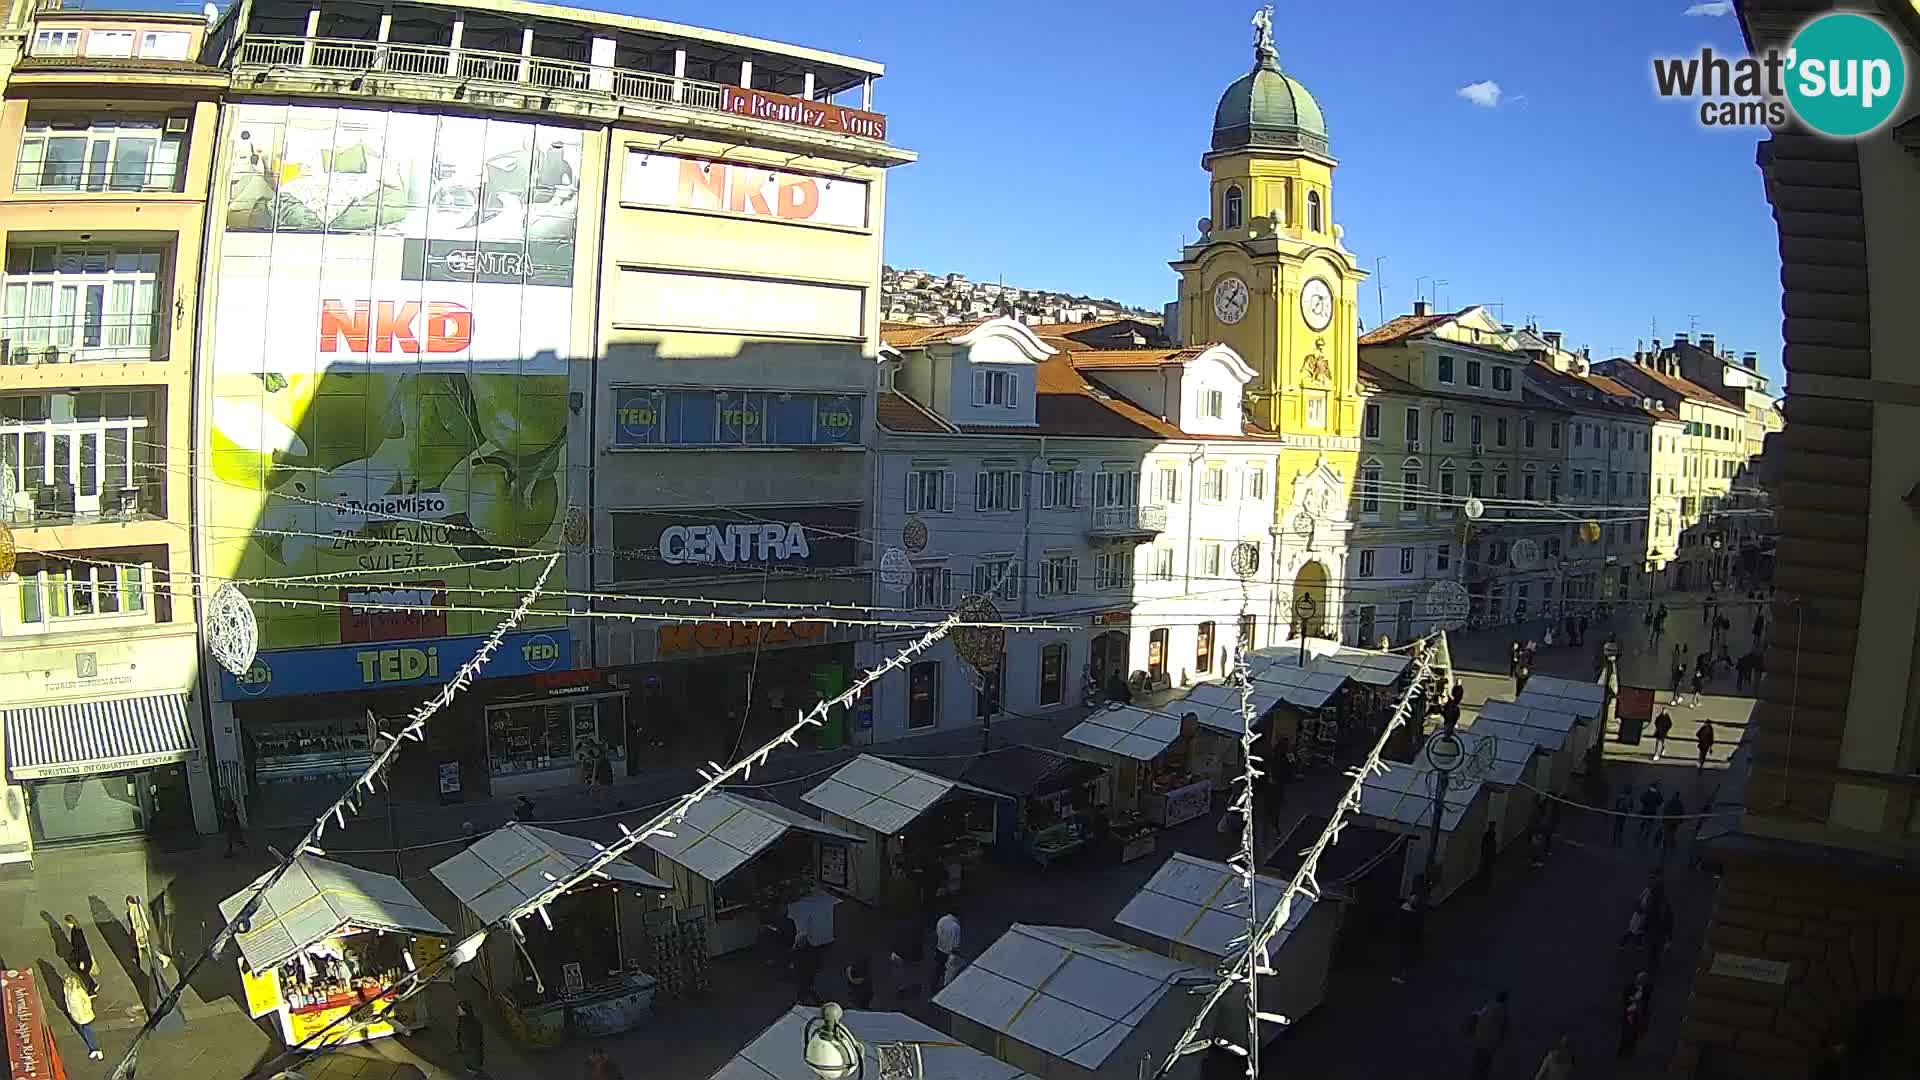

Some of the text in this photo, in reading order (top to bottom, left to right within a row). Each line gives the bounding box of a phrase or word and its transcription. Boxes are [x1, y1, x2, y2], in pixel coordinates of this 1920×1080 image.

[722, 88, 745, 113] Le
[678, 160, 819, 219] NKD
[446, 250, 535, 277] CENTRA
[320, 299, 475, 353] NKD
[617, 408, 657, 425] TEDi
[722, 410, 759, 426] TEDi
[819, 411, 853, 427] TEDi
[336, 498, 445, 517] #TvojeMisto
[659, 522, 809, 564] CENTRA
[521, 642, 560, 662] TEDi
[356, 646, 439, 682] TEDi
[236, 665, 272, 687] EDi
